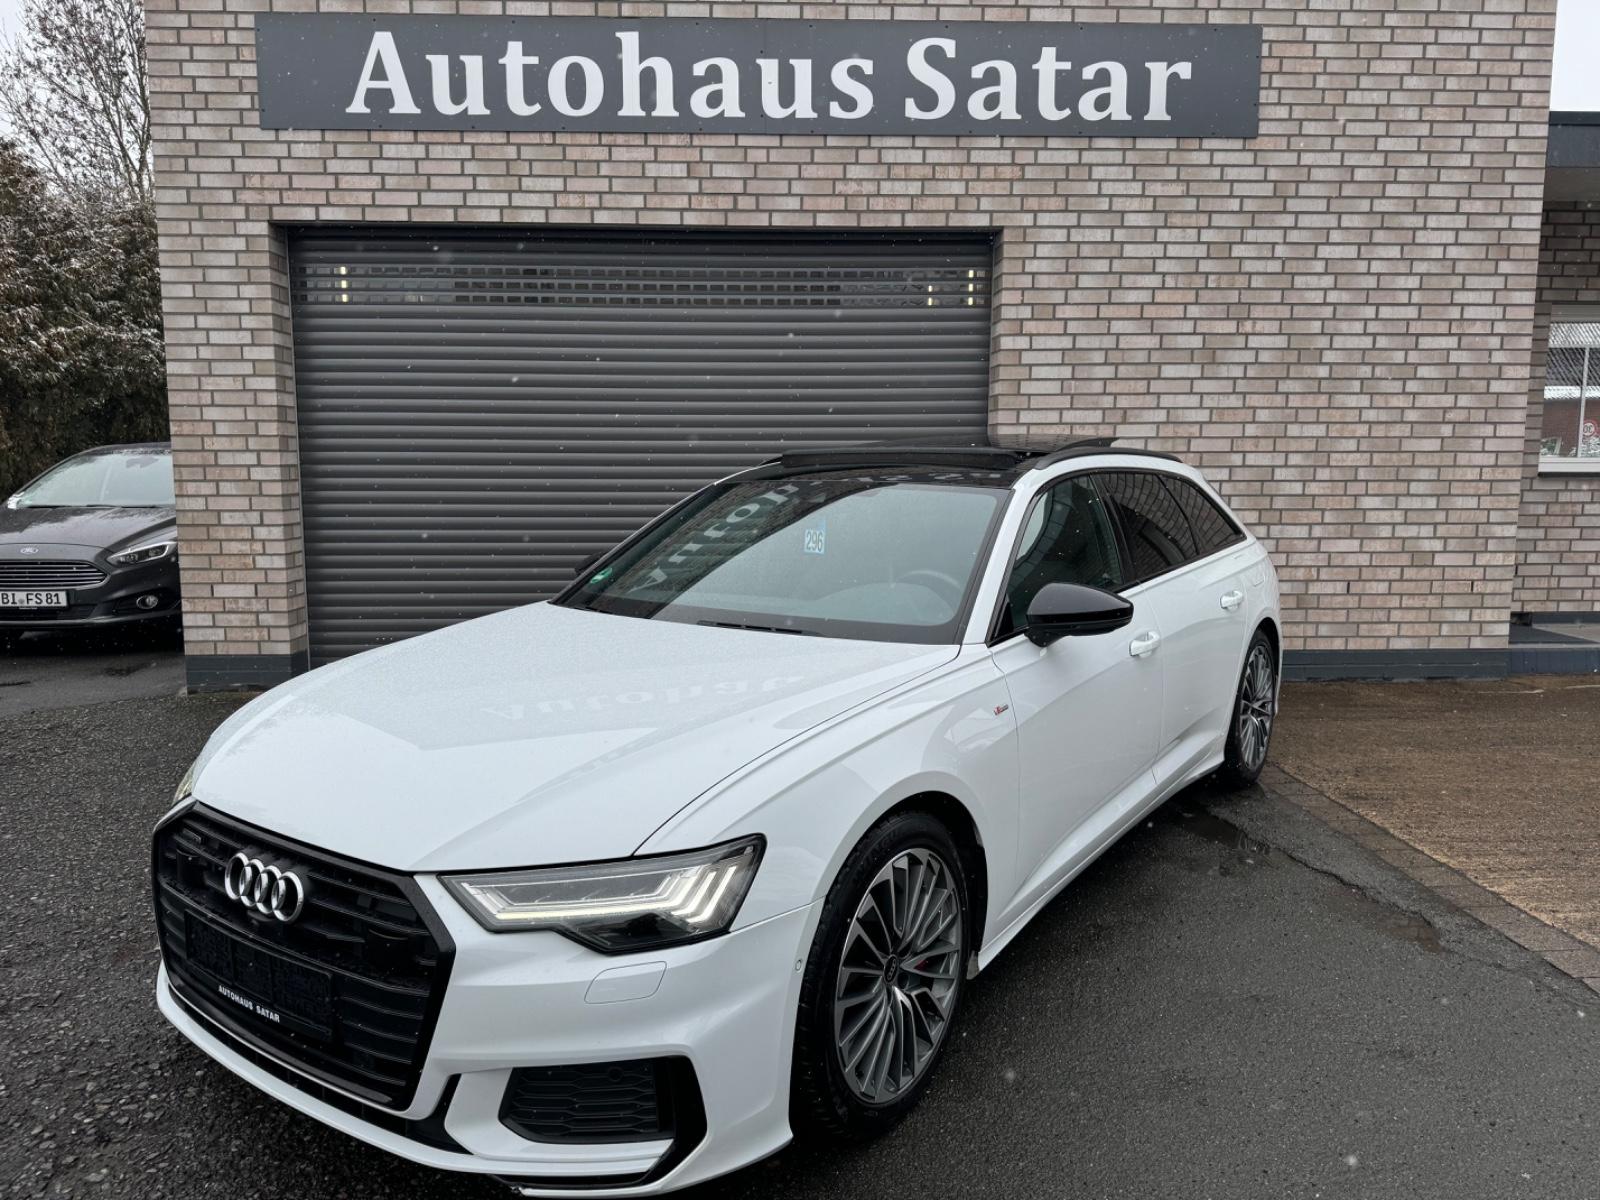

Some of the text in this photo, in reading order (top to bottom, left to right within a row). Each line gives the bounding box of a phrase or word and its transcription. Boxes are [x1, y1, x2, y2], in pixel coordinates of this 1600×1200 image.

[345, 30, 1193, 121] Autohaus Satar
[806, 531, 824, 553] 296
[1, 593, 61, 604] BI FS 81
[218, 985, 280, 1023] AUTOHAUS SATAR
